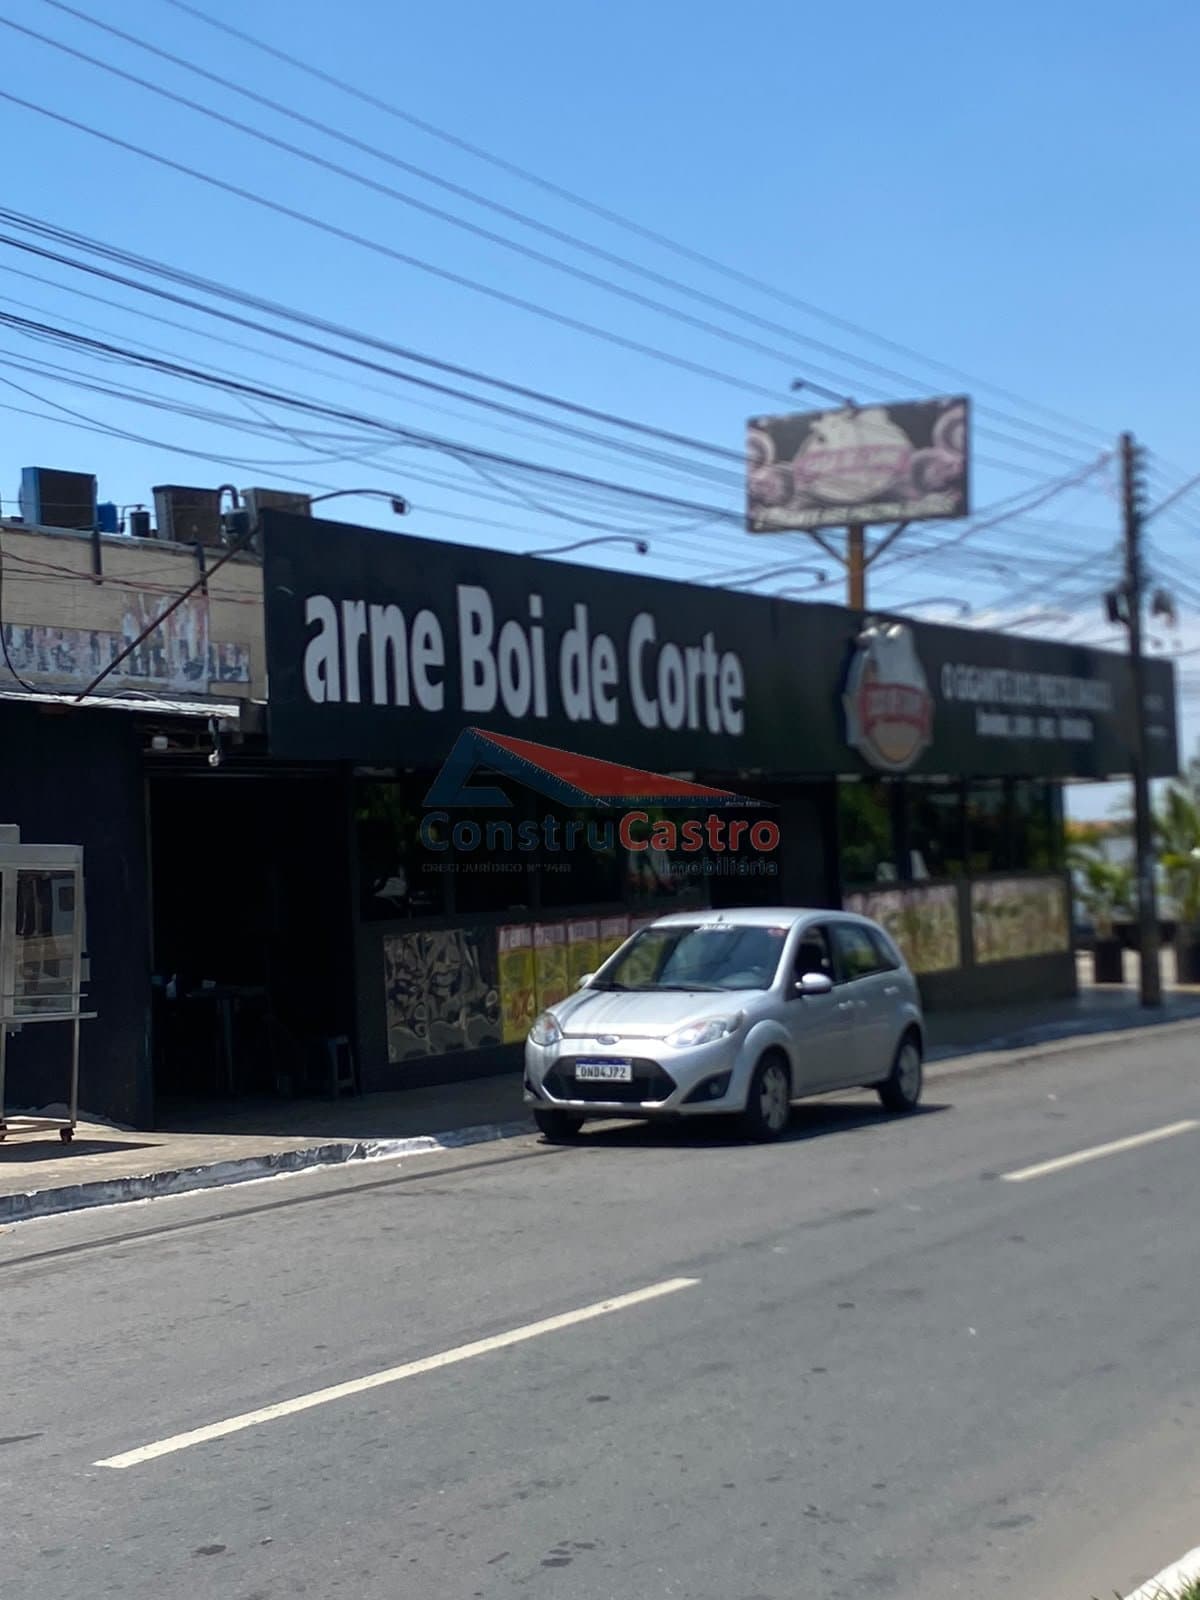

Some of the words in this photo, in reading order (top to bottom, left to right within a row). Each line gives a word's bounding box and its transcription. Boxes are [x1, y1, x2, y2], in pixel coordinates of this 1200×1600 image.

[305, 595, 446, 711] arne
[457, 585, 547, 719] Boi
[560, 603, 619, 725] de
[629, 612, 744, 735] Corte
